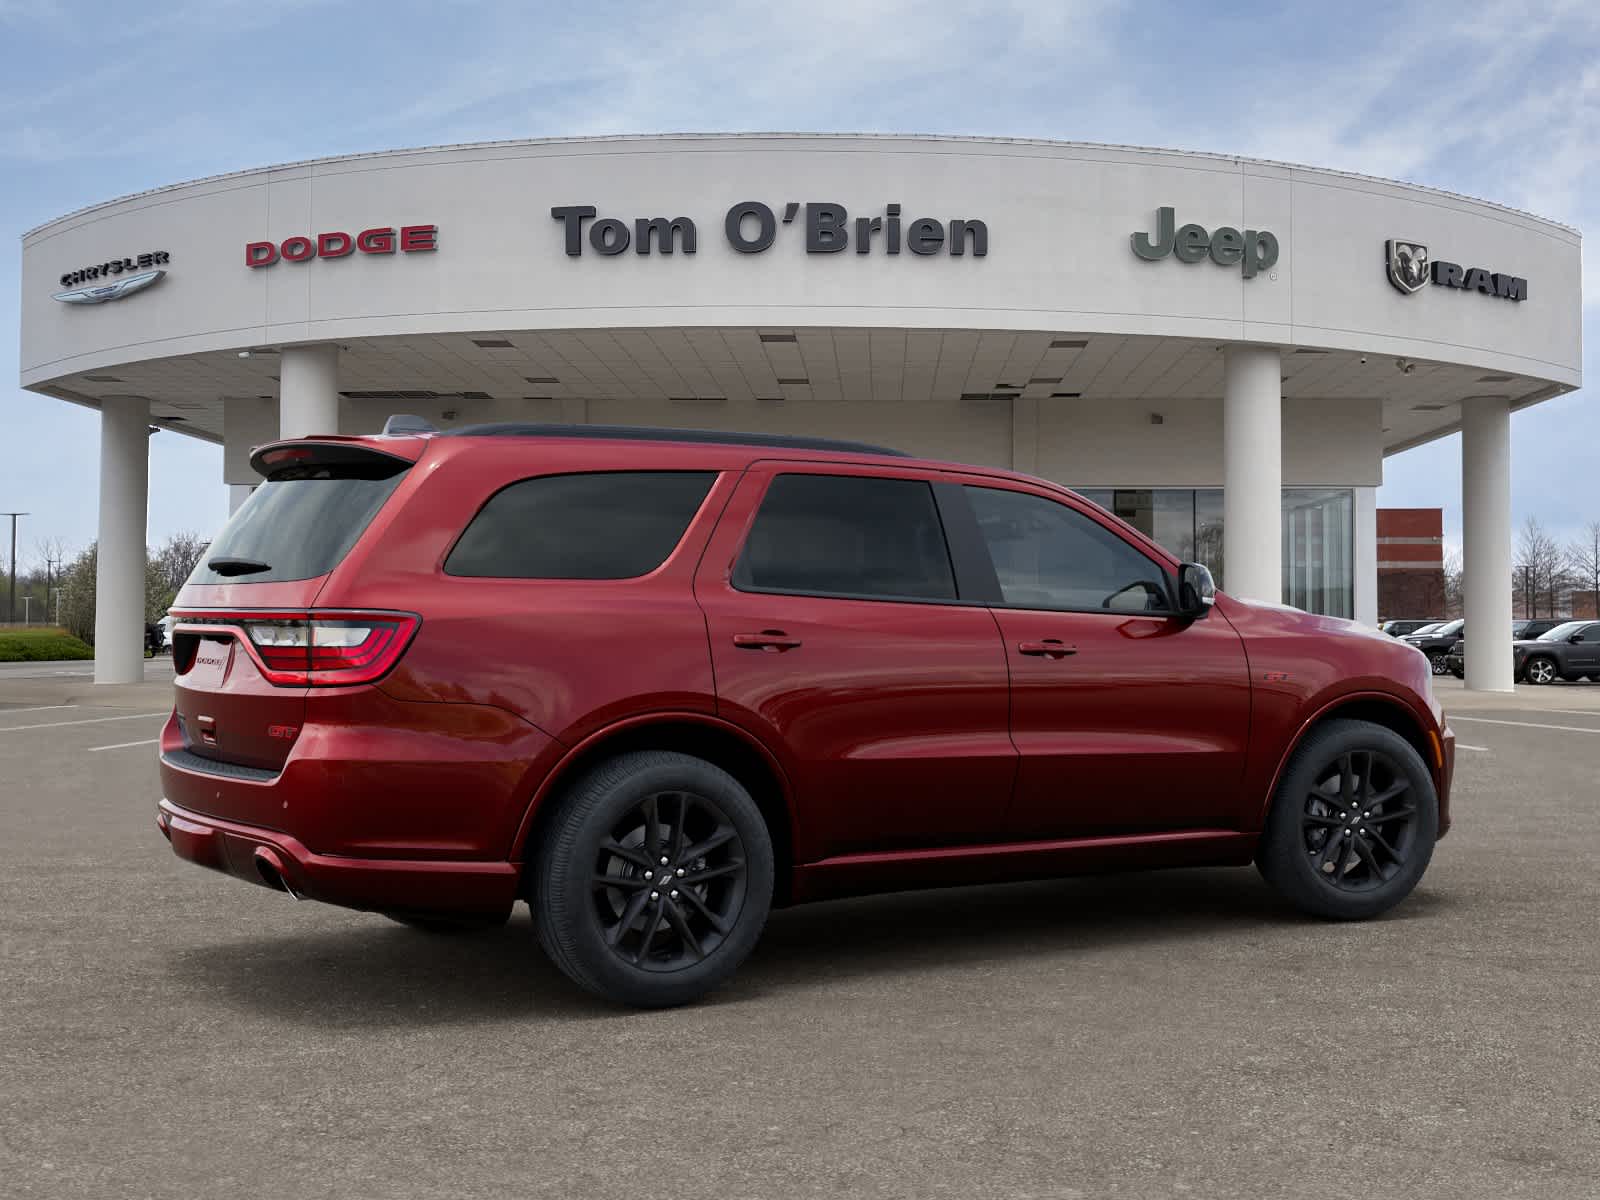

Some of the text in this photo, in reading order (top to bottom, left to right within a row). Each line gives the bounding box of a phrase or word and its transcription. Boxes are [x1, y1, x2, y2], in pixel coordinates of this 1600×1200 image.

[245, 224, 439, 268] DODGE
[551, 205, 697, 256] Tom
[1130, 206, 1280, 279] Jeep
[60, 250, 171, 287] CHRYSLER
[1431, 260, 1528, 301] RAM
